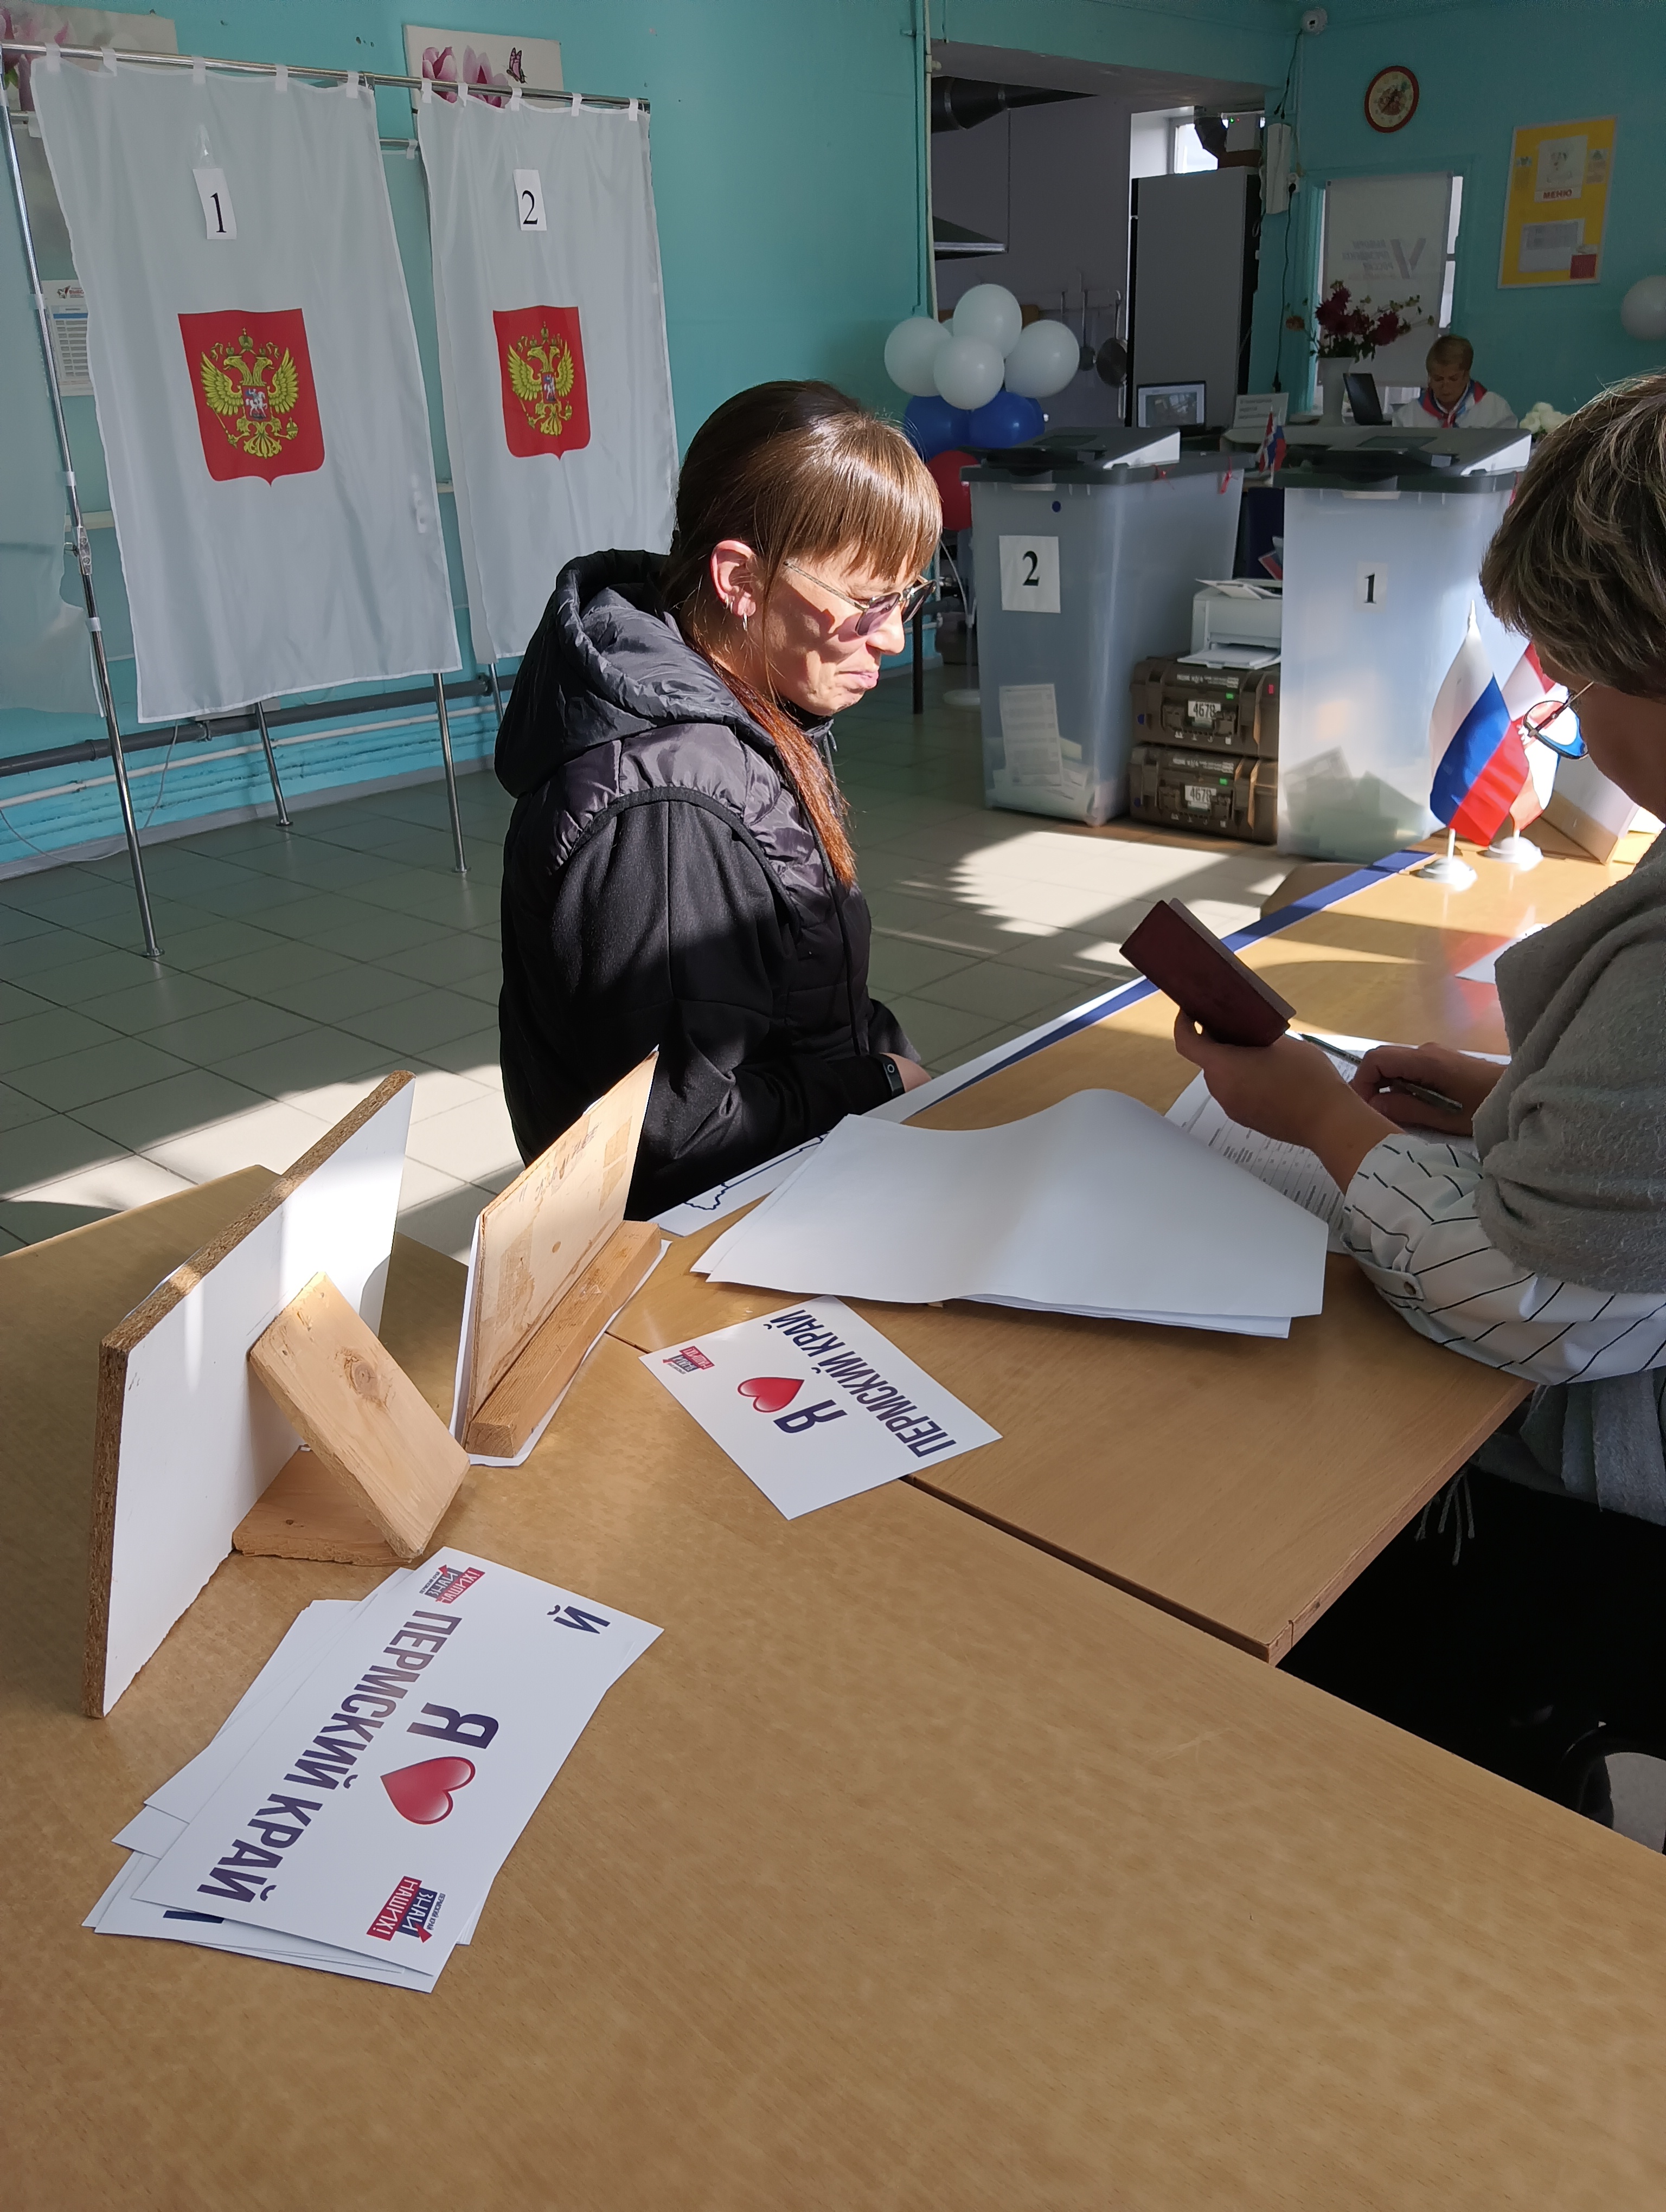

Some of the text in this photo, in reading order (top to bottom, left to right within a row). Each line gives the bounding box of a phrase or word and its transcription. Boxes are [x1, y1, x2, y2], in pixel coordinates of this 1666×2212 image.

[210, 192, 227, 233] 1
[522, 190, 538, 225] 2
[1543, 189, 1573, 200] МЕНЮ
[1022, 550, 1040, 587] 2
[1363, 573, 1377, 604] 1
[763, 1309, 957, 1457] ПЕРМСКИЙ КРАЙ
[773, 1399, 848, 1433] Я
[406, 1702, 499, 1750] Я
[196, 1610, 462, 1903] ПЕРМСКИЙ КРАЙ
[373, 1879, 418, 1935] НАШИХ!
[426, 1893, 446, 1931] ПЕРМСКИЙ КРАЙ
